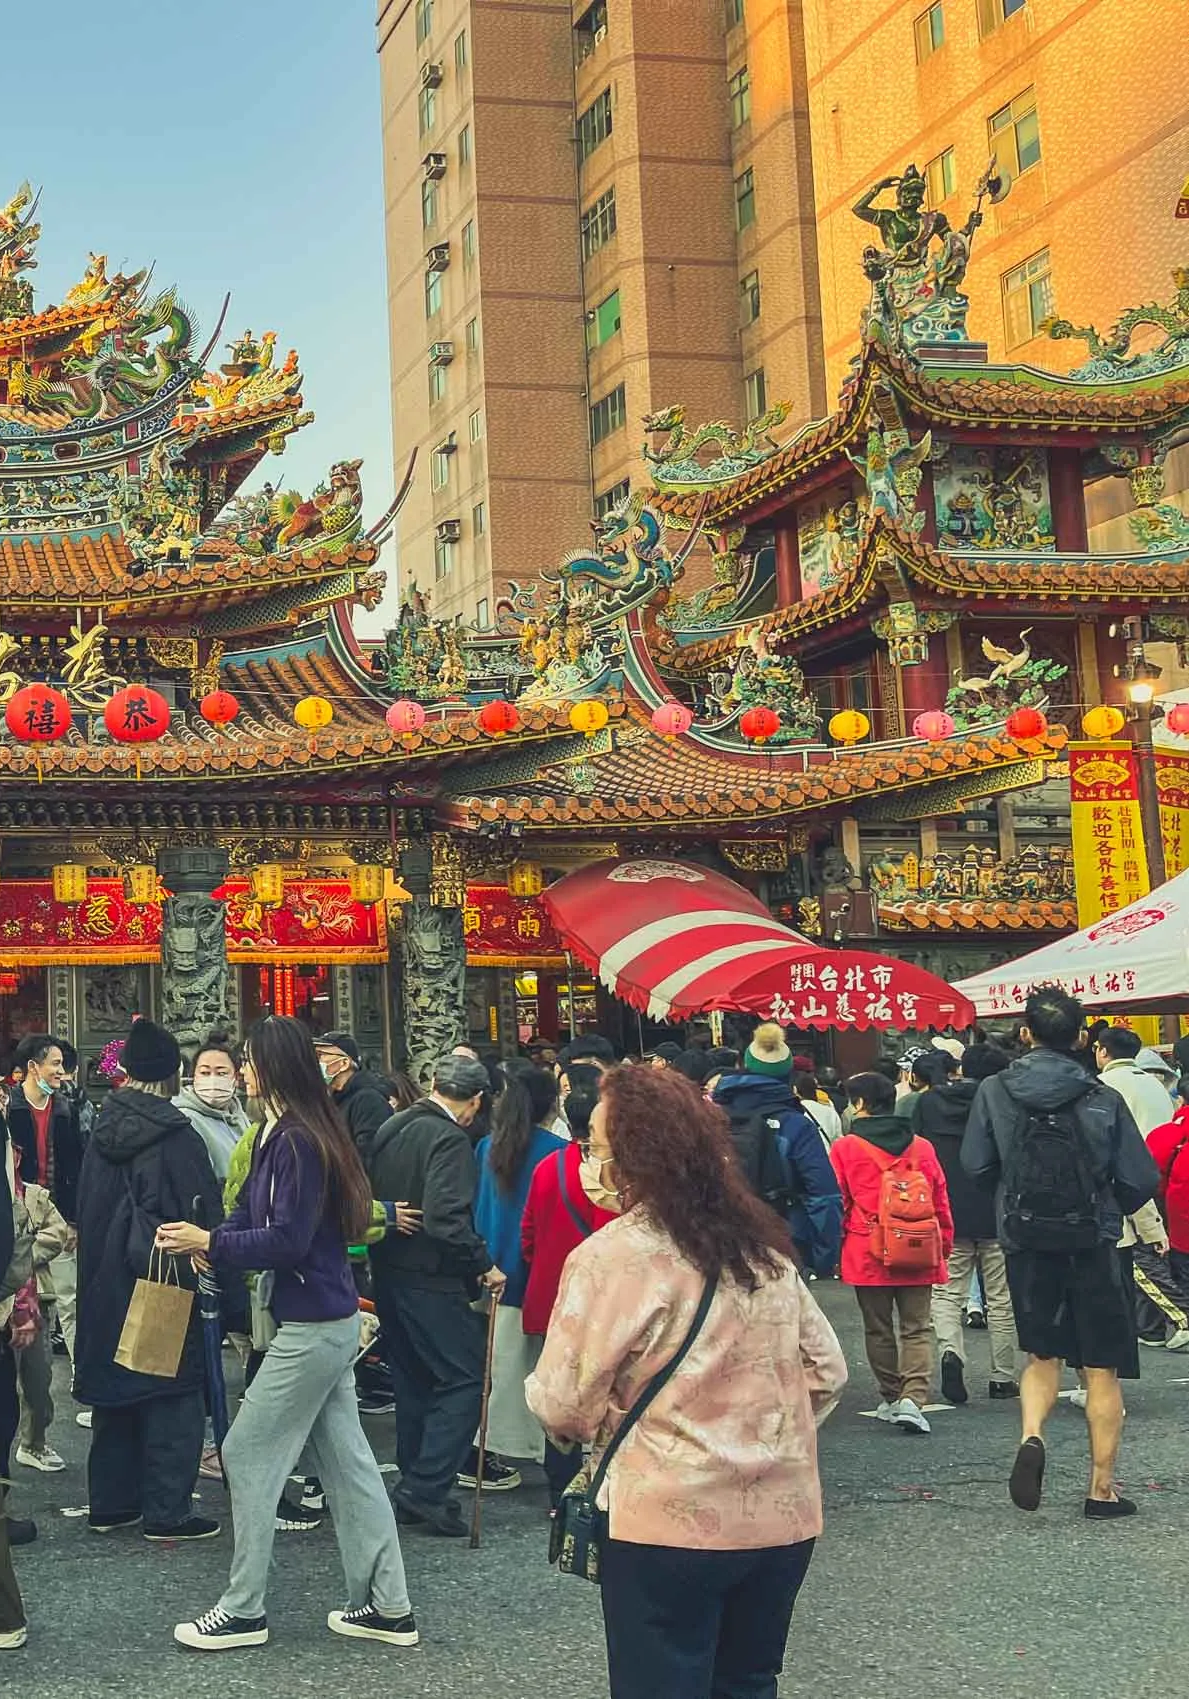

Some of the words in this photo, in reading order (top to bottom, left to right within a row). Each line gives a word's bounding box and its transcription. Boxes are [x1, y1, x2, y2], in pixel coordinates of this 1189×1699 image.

[25, 700, 60, 735] 禧
[122, 698, 157, 731] 恭
[818, 965, 894, 991] 台北市
[769, 992, 920, 1022] 松山慈祐宮
